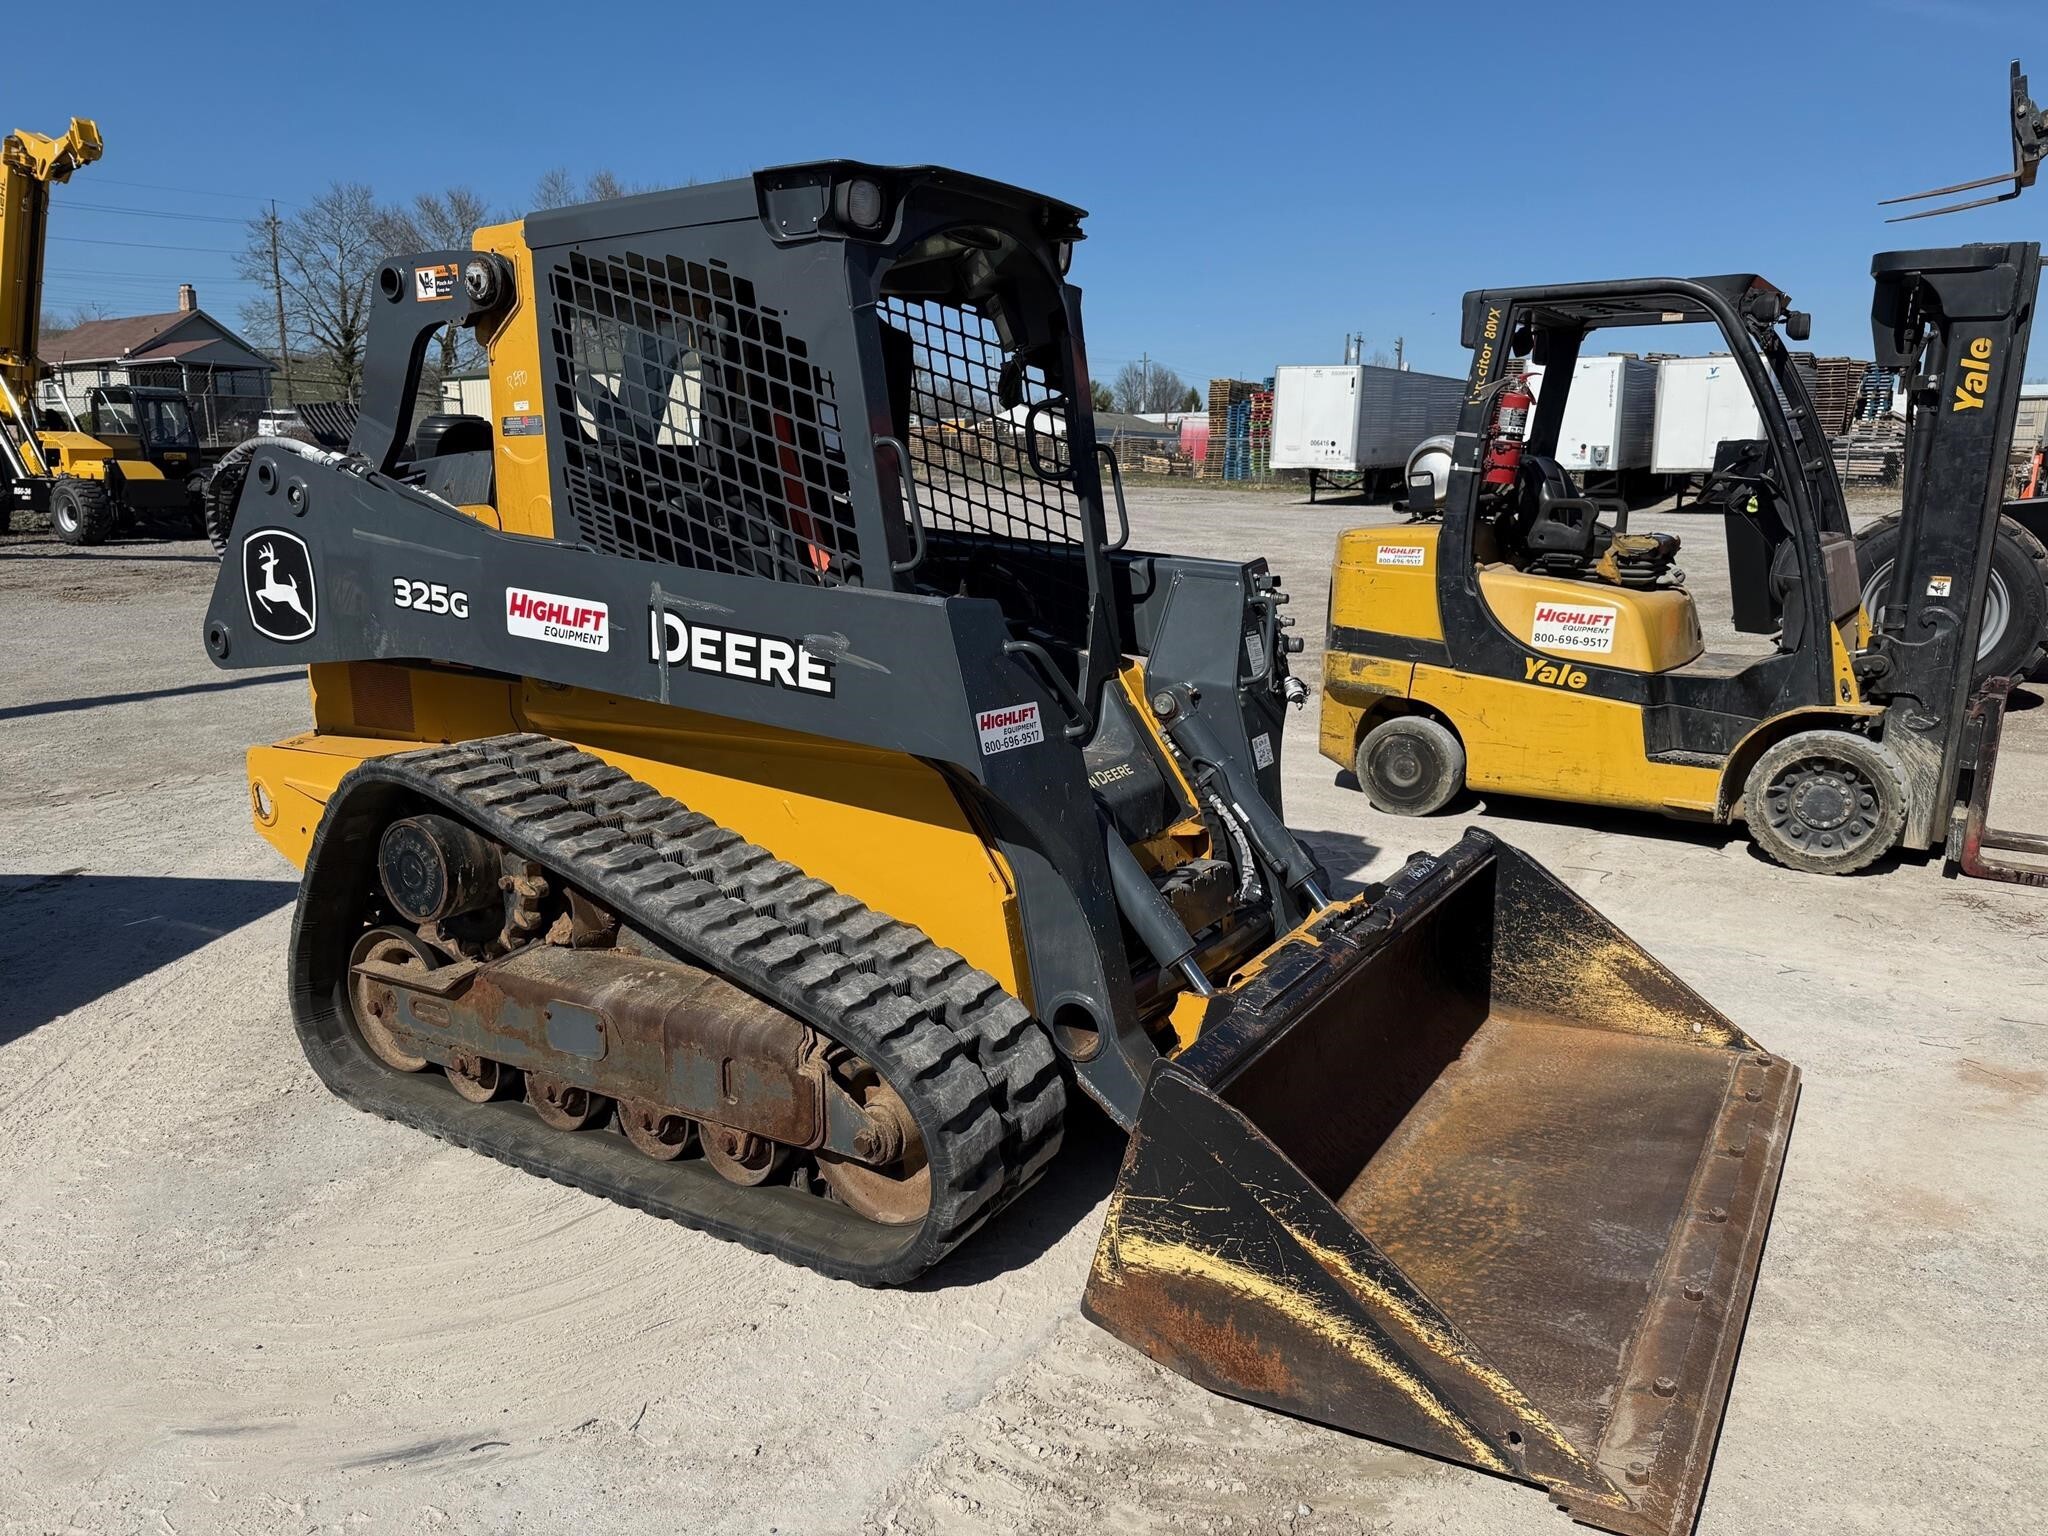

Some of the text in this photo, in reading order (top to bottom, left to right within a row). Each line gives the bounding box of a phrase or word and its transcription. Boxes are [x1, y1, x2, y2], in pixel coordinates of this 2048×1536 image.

[1484, 307, 1502, 339] 80VX
[1953, 337, 1993, 412] Yale
[1379, 546, 1423, 555] HIGHLIFT
[393, 578, 469, 619] 325G
[509, 592, 606, 632] HIGHLIFT
[1536, 608, 1614, 627] HIGHLIFT
[544, 625, 604, 646] EQUIPMENT
[1533, 632, 1609, 648] 800-696-9517
[1562, 624, 1610, 634] EQUIPMENT
[650, 608, 833, 695] DEERE
[1524, 657, 1588, 689] Yale
[980, 706, 1036, 732] HIGHLIFT
[1003, 721, 1037, 736] EQUIPMENT
[984, 730, 1040, 754] 800-696-9517
[1093, 763, 1135, 785] DEERE
